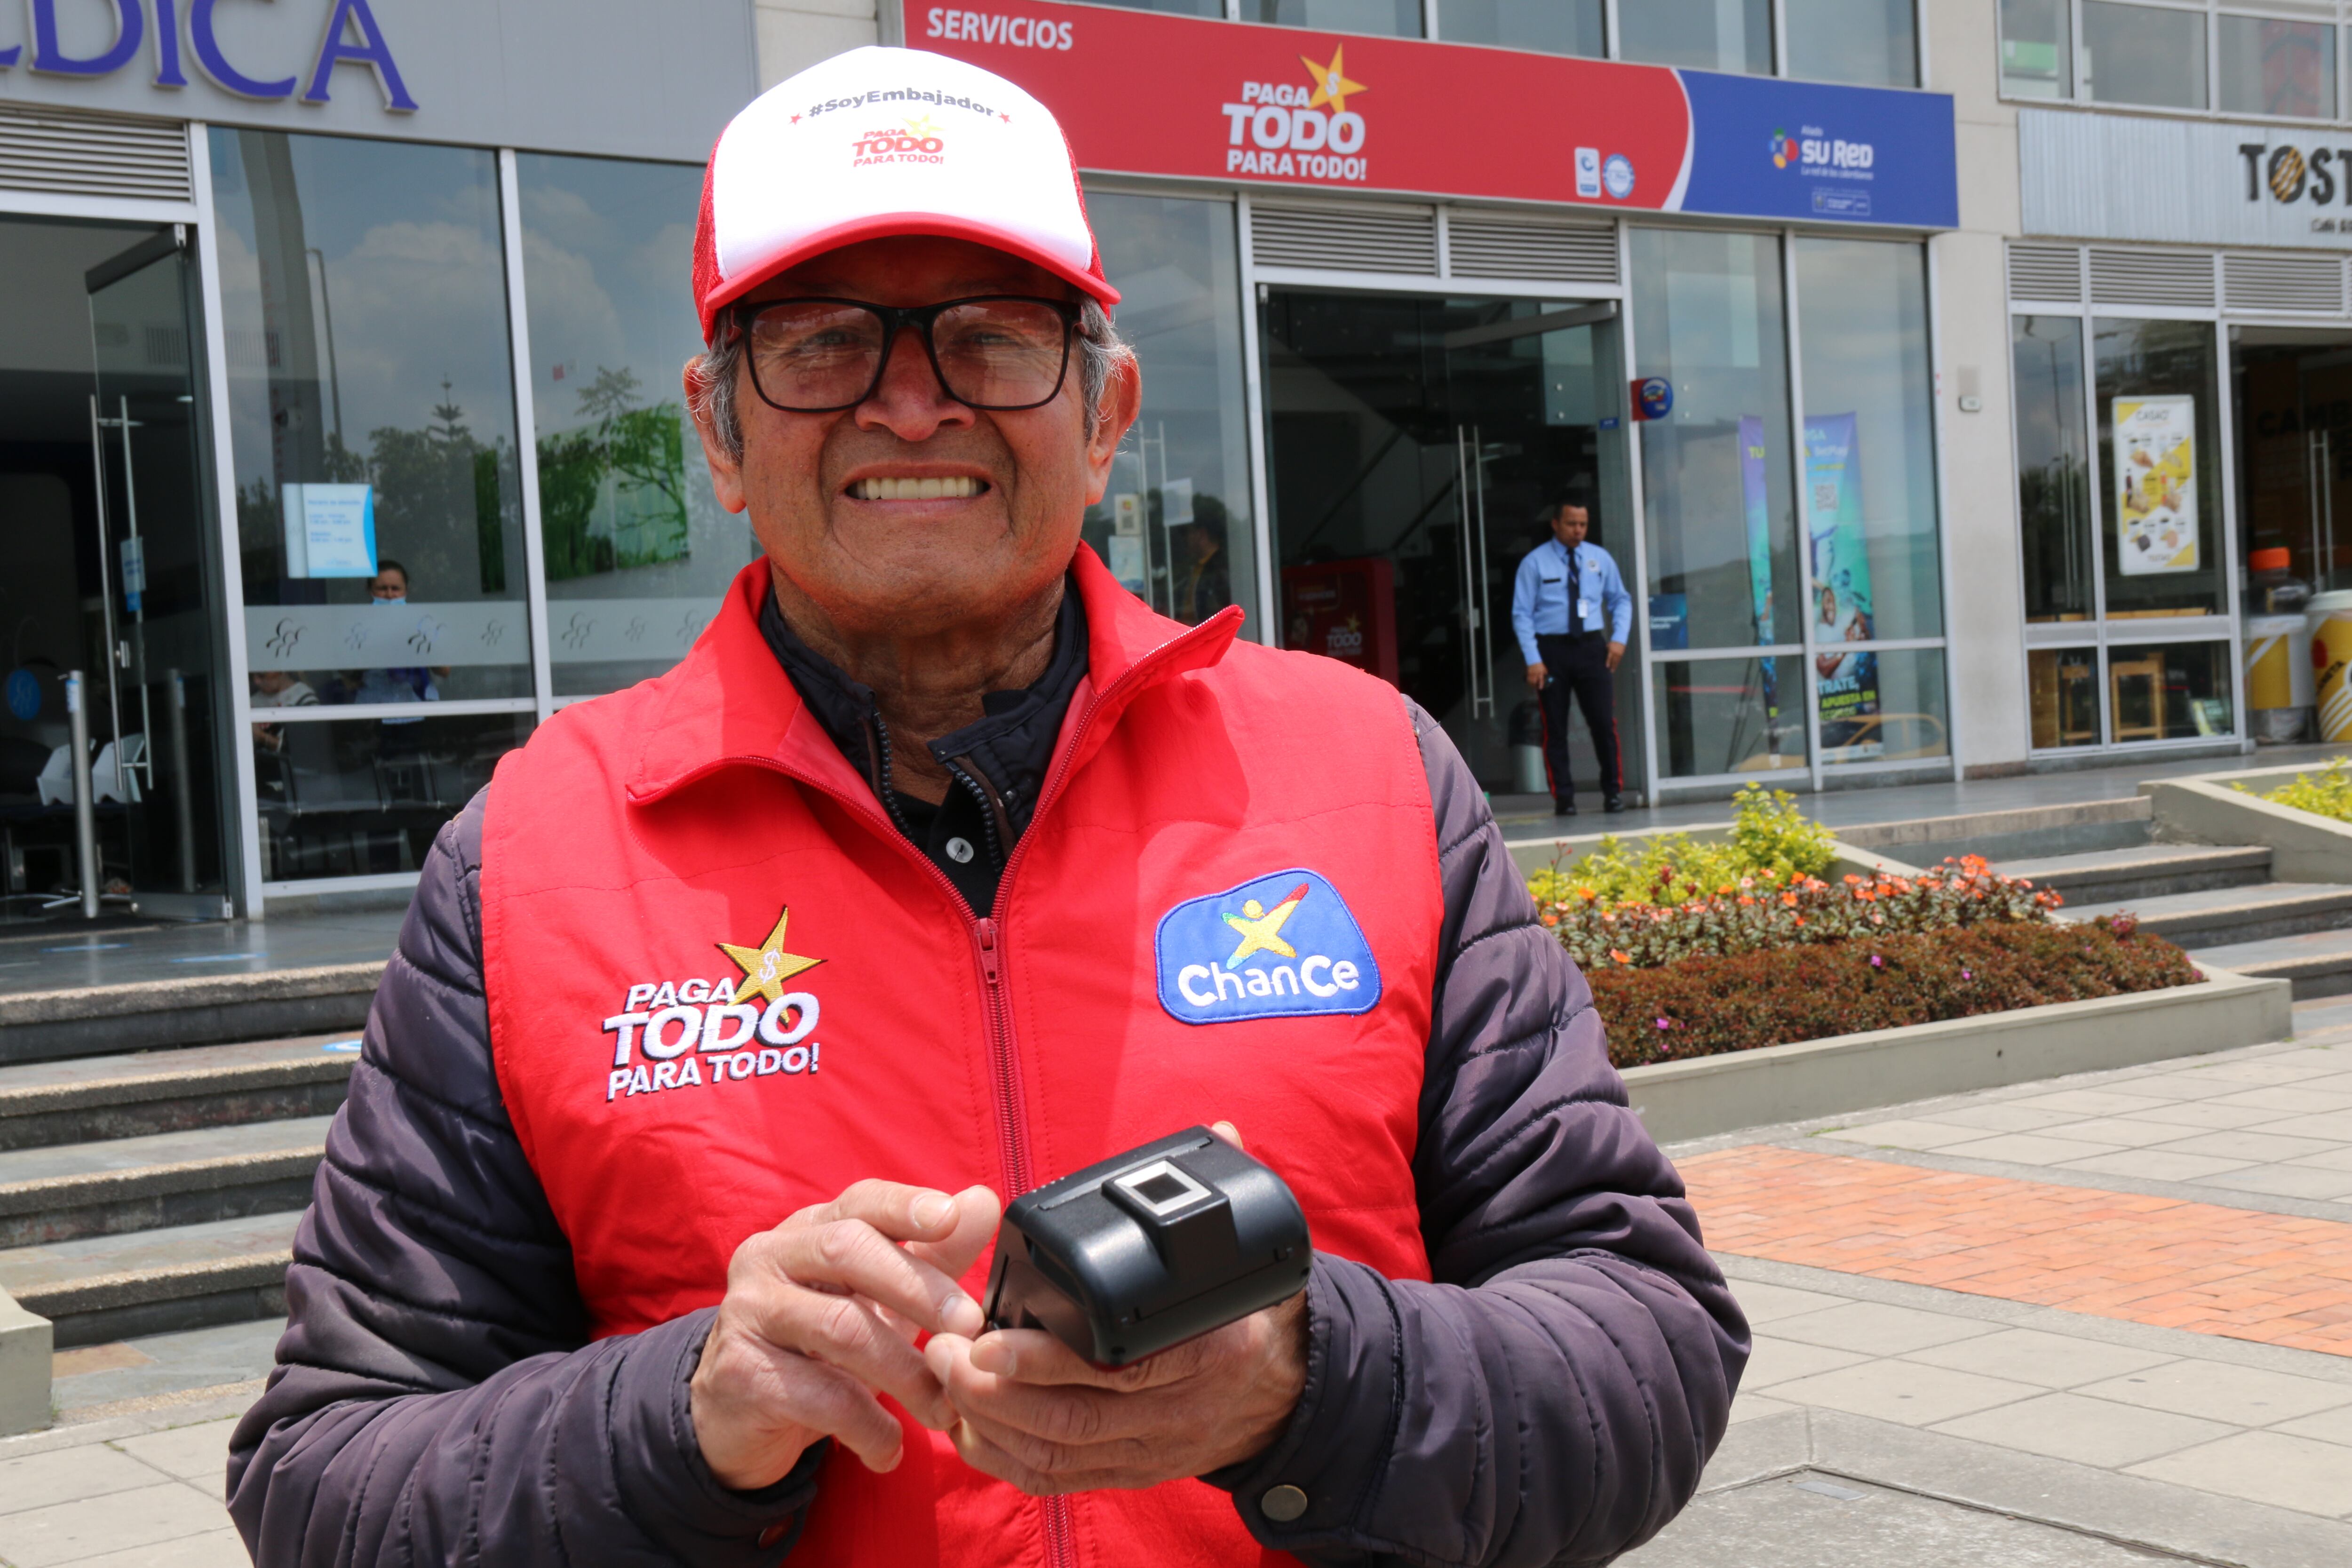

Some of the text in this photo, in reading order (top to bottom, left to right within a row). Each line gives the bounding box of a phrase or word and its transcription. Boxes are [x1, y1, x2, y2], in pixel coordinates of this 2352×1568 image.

[927, 7, 1073, 51] SERVICIOS
[0, 0, 419, 111] DICA
[809, 88, 994, 117] #SoyEmbajador
[1242, 81, 1311, 108] PAGA
[852, 137, 944, 157] TODO
[863, 128, 908, 140] PAGA
[1222, 103, 1366, 155] TODO
[853, 153, 944, 167] PARA TODO!
[1226, 149, 1367, 181] PARA TODO!
[758, 947, 780, 984] $
[1177, 955, 1360, 1008] ChanCe
[625, 977, 736, 1013] PAGA
[603, 991, 821, 1067] TODO
[606, 1042, 820, 1103] PARA TODO!
